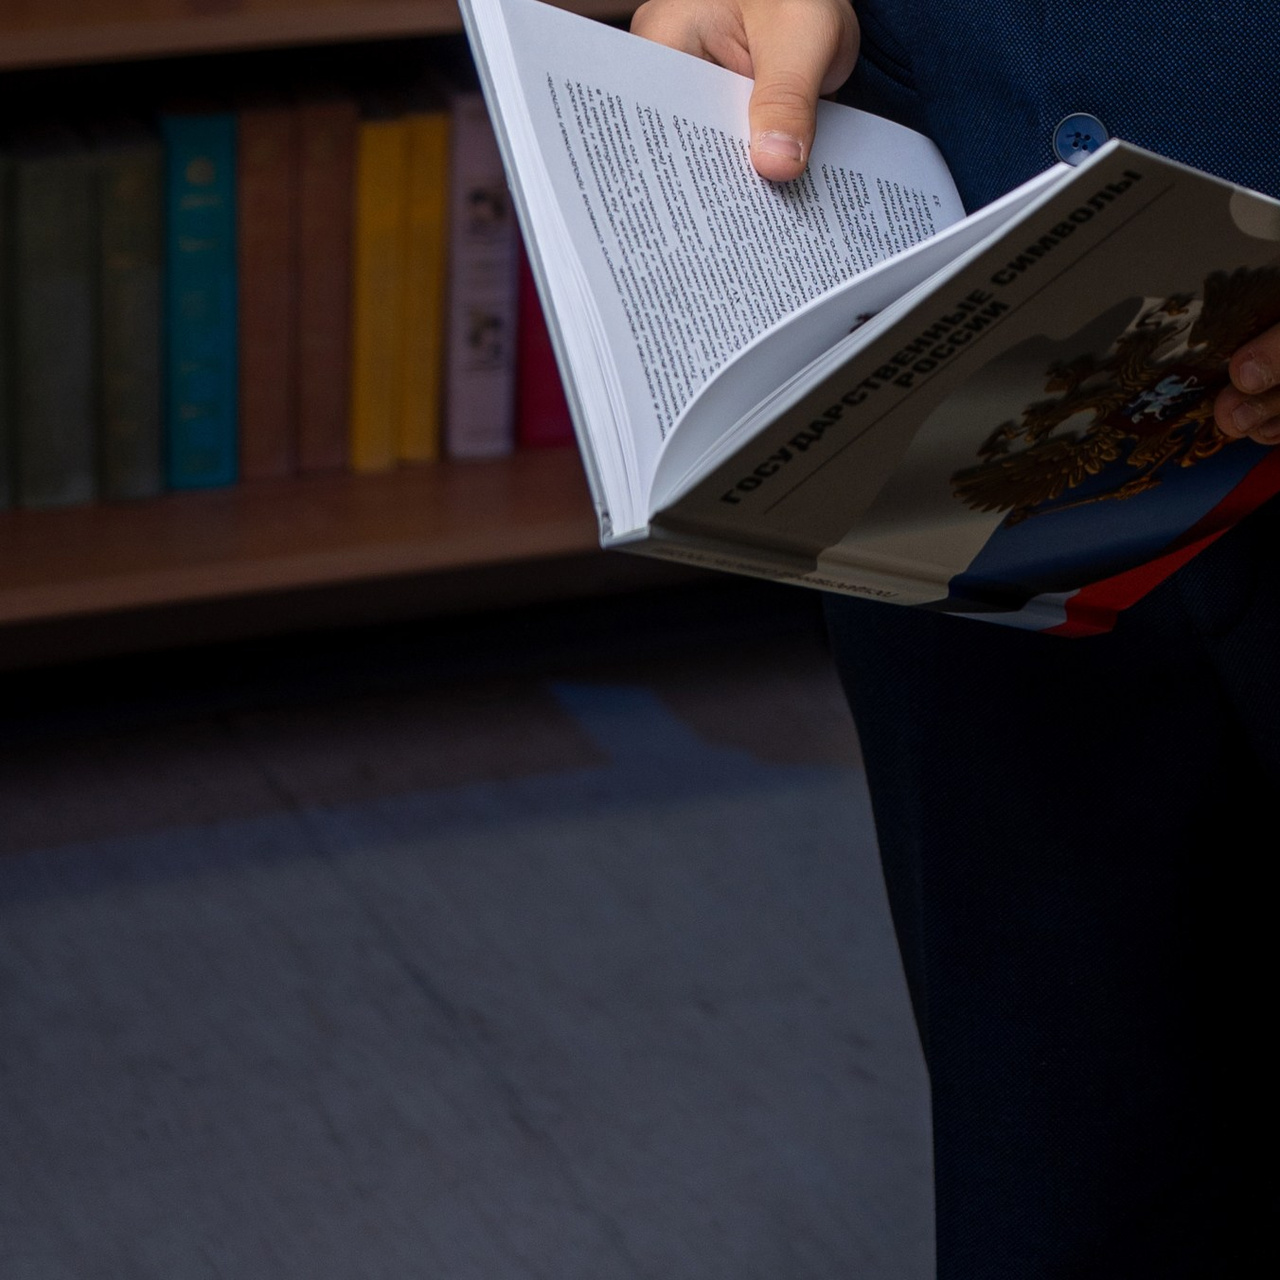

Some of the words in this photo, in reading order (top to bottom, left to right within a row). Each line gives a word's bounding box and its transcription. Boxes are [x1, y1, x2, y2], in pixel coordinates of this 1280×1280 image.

[883, 231, 893, 256] ода.
[720, 286, 994, 507] ГОСУДАРСТВЕННЫЕ
[991, 168, 1144, 287] СИМВОЛЫ
[895, 299, 1012, 390] РОССИИ
